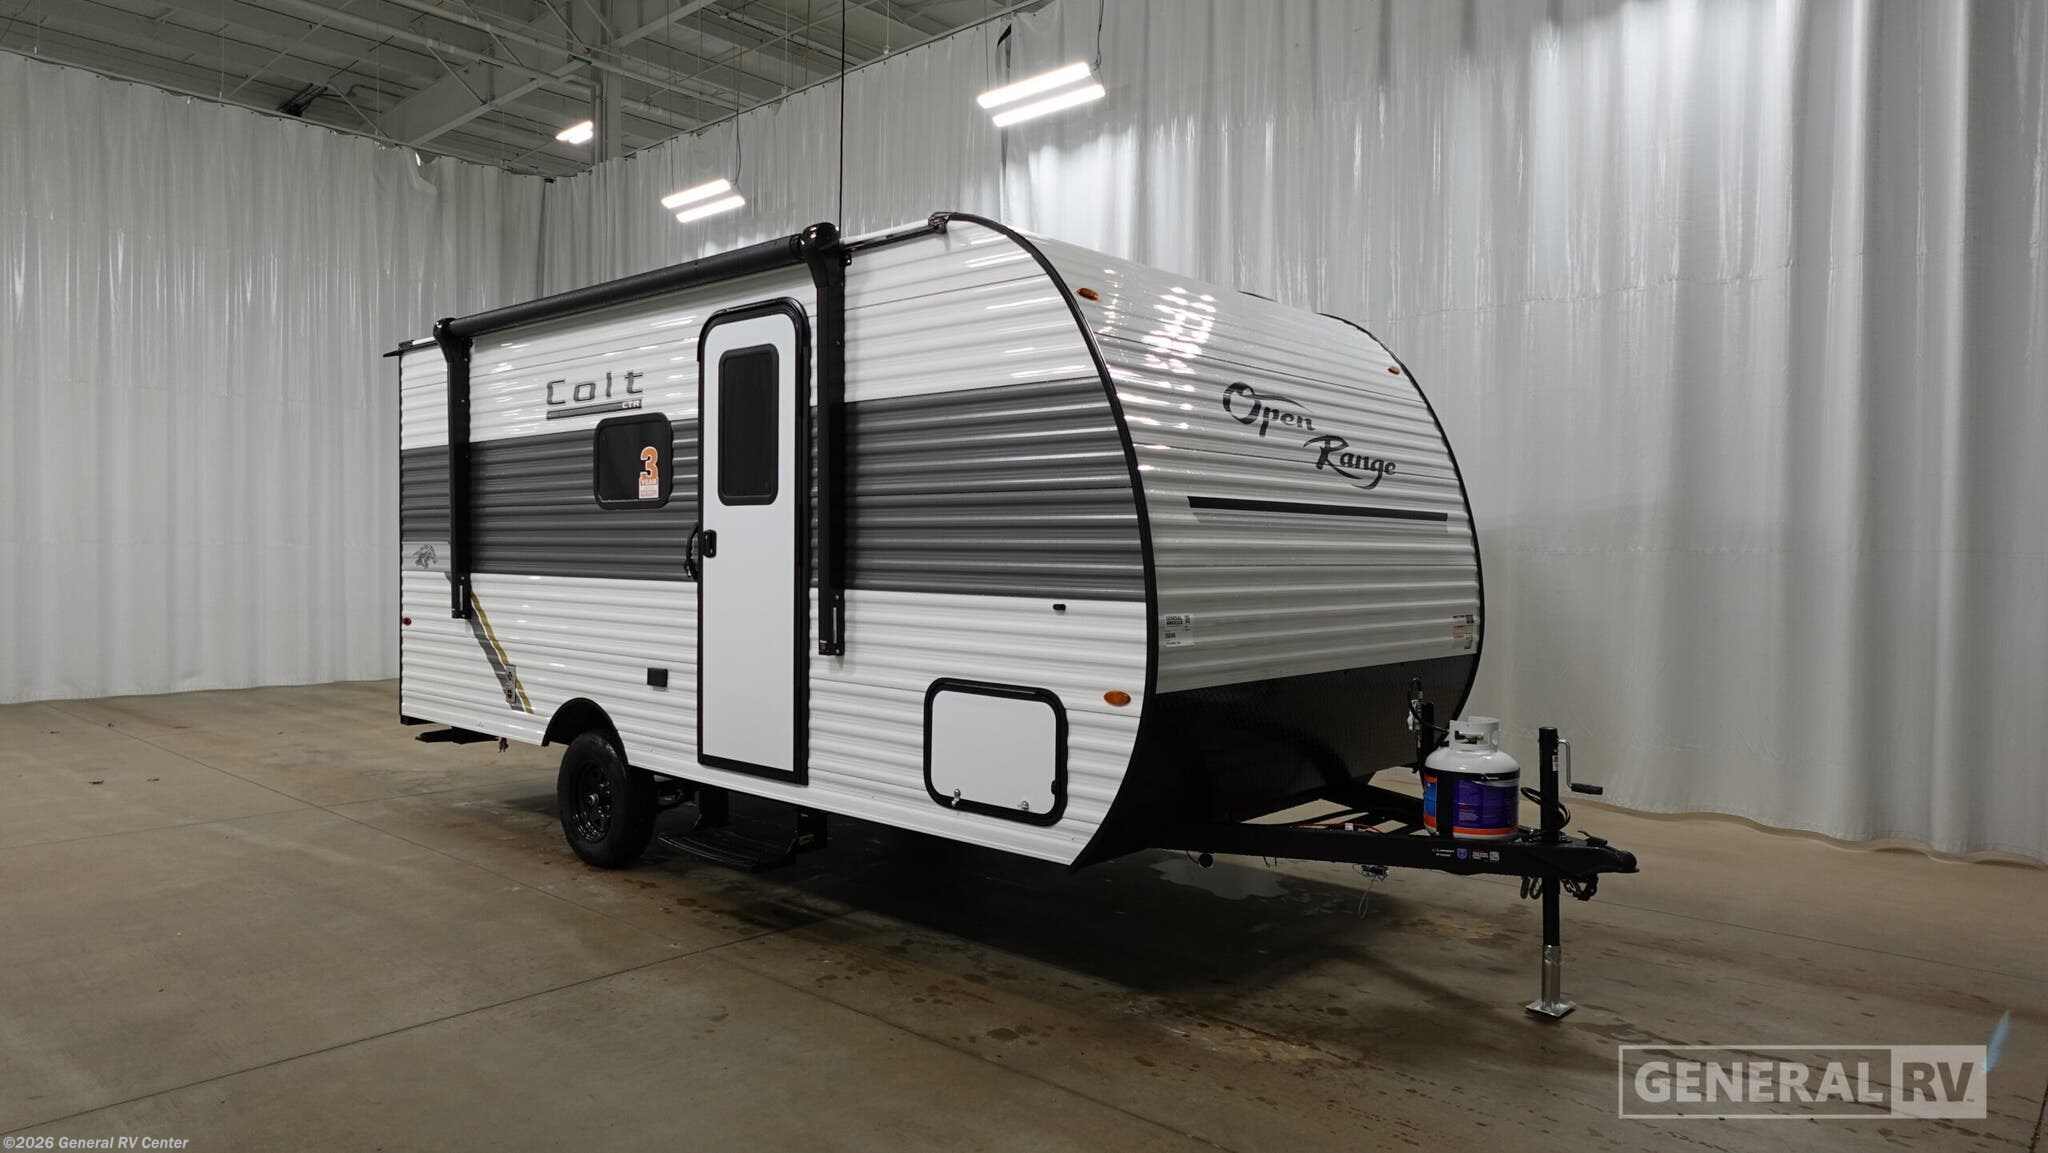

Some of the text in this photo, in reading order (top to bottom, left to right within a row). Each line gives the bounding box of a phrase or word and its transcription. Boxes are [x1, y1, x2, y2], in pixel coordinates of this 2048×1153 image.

[546, 371, 644, 406] Colt
[622, 400, 640, 409] CTR
[1222, 381, 1317, 437] Open
[640, 446, 658, 480] 3
[1302, 434, 1397, 490] Range
